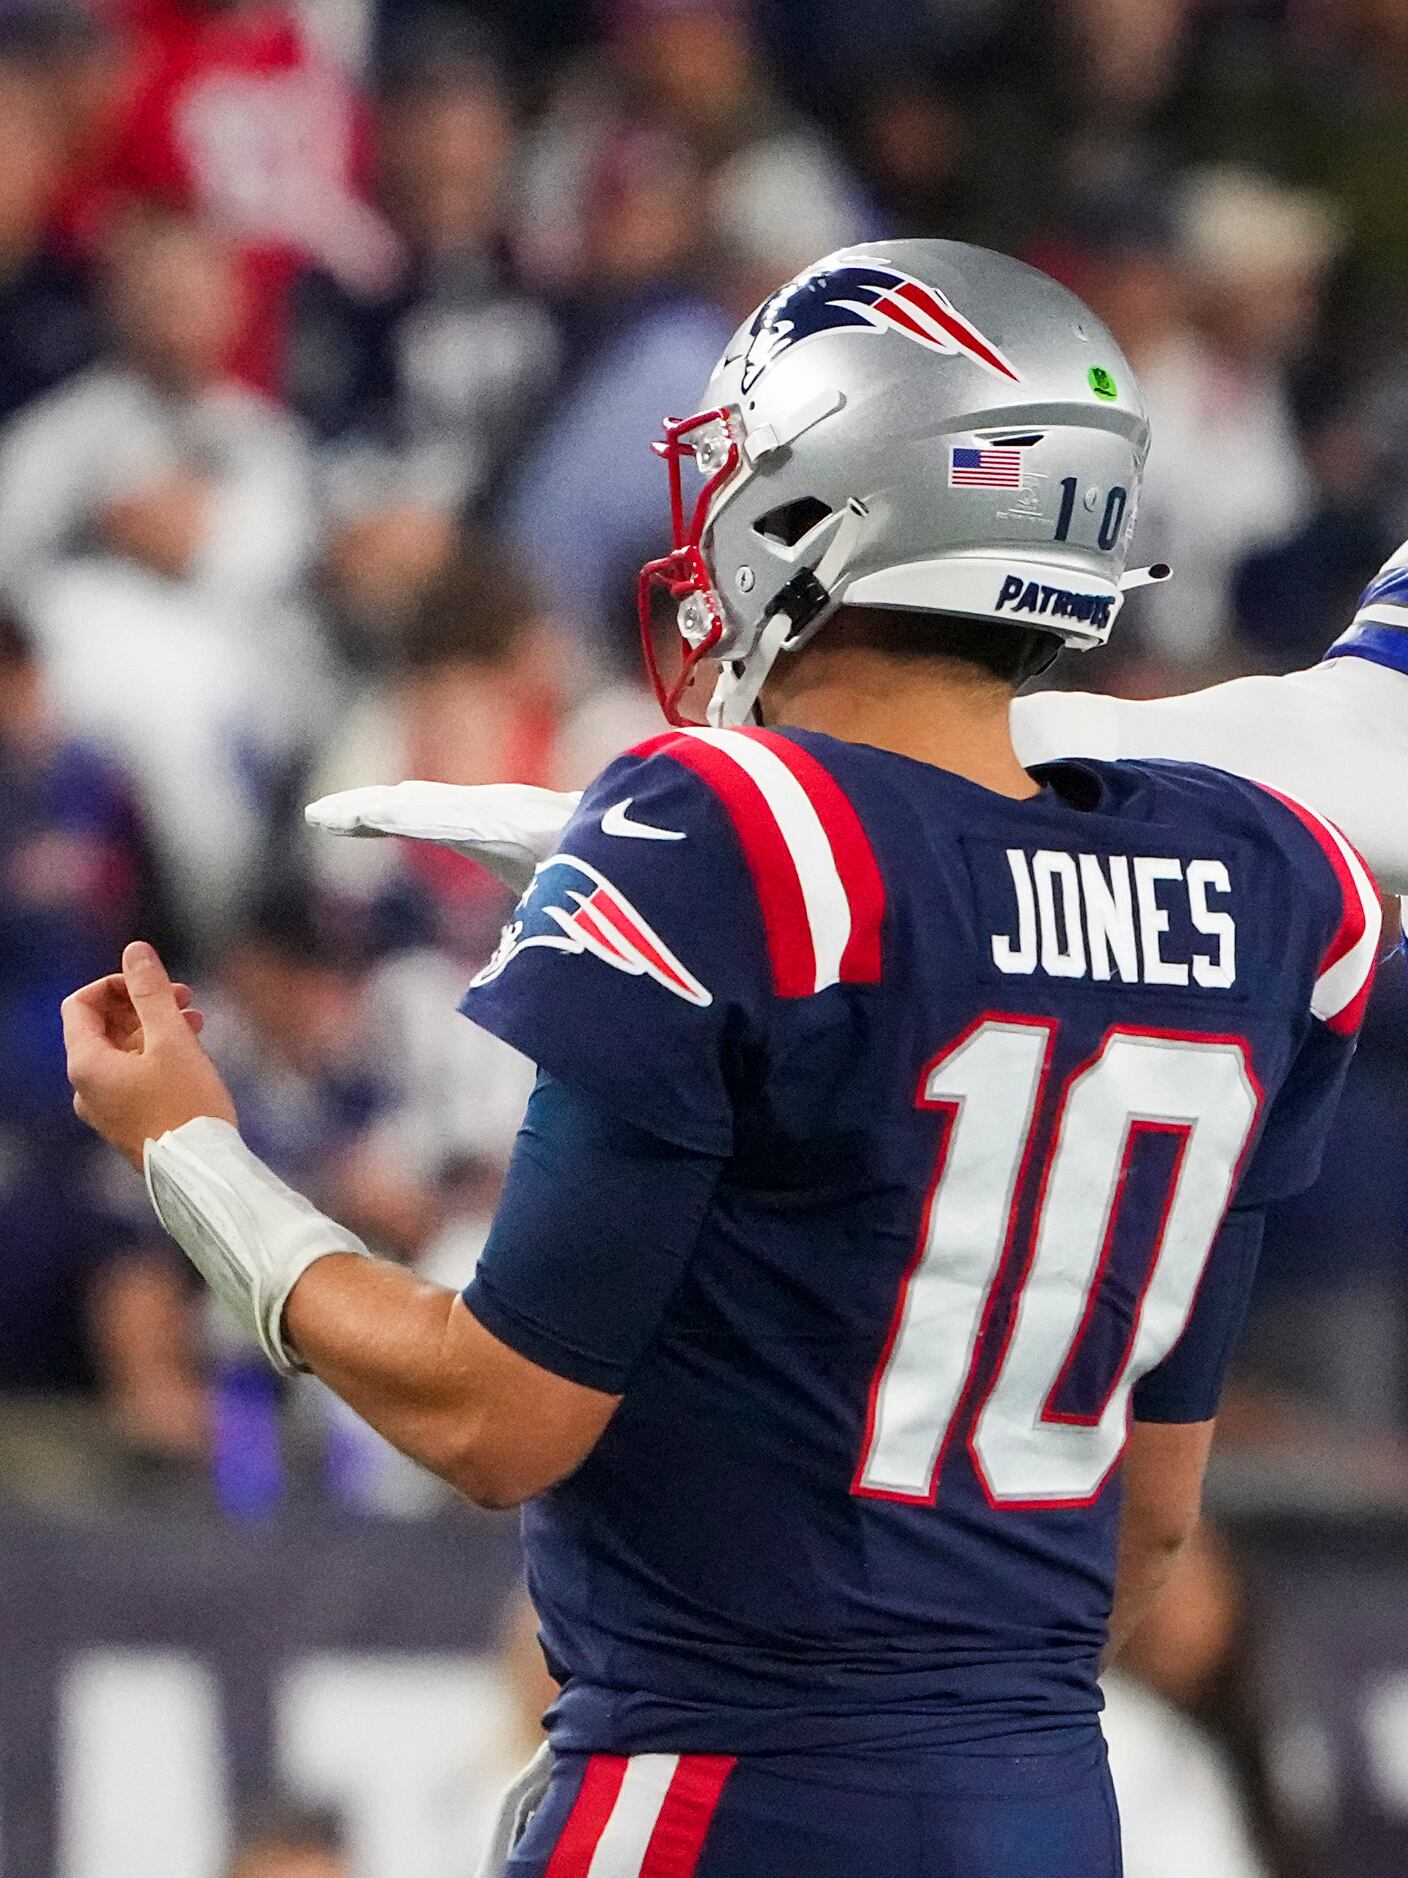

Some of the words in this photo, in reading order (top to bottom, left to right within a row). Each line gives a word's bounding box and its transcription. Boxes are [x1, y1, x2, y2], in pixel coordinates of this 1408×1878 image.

[1054, 477, 1127, 551] 10
[992, 848, 1235, 988] JONES
[851, 1010, 1264, 1511] 10
